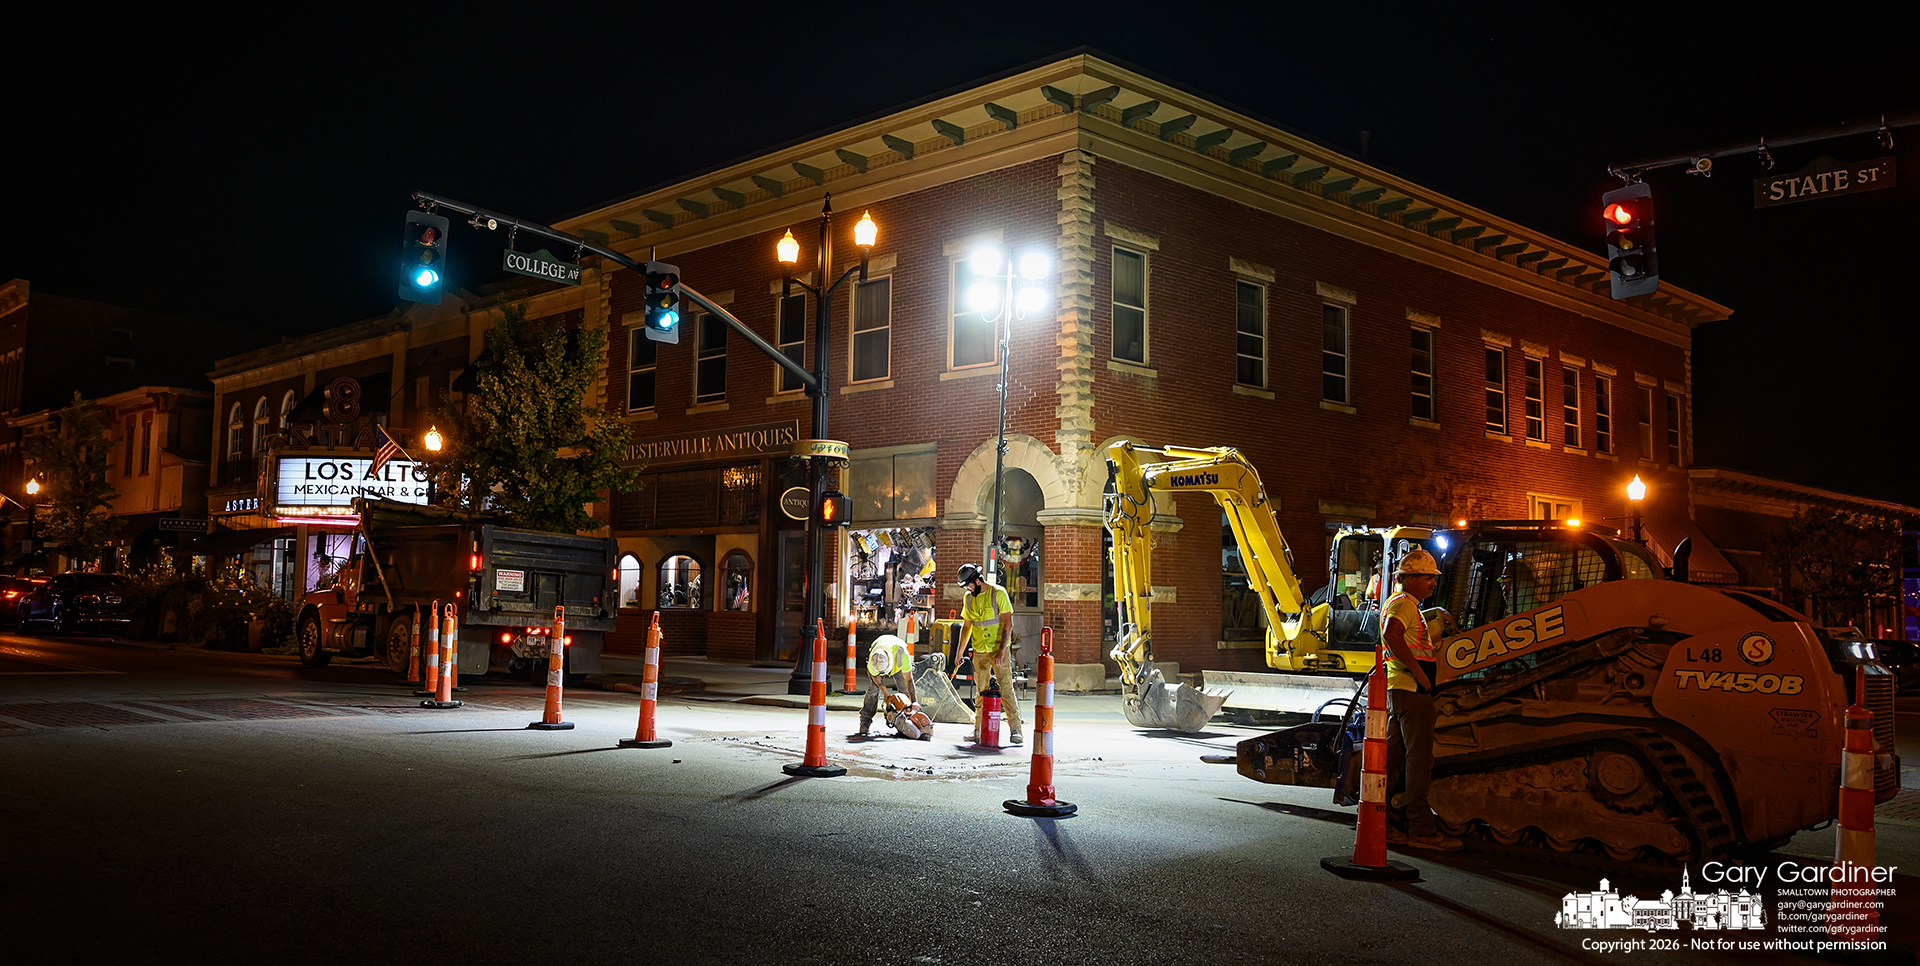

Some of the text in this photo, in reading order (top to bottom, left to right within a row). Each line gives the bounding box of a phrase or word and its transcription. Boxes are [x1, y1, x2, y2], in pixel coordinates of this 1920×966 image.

[1769, 167, 1880, 200] STATE ST
[507, 253, 566, 279] COLLEGE
[290, 424, 410, 453] STAT
[715, 426, 793, 452] ANTIQUES
[305, 461, 429, 482] LOS ALTO
[1170, 471, 1218, 487] KOMATSU
[294, 484, 360, 495] MEXICAN
[368, 485, 395, 497] BAR
[400, 487, 409, 497] &
[784, 498, 809, 508] ANTIQU
[225, 497, 259, 512] ASTER
[1445, 605, 1565, 669] CASE
[1674, 670, 1805, 695] TV450B
